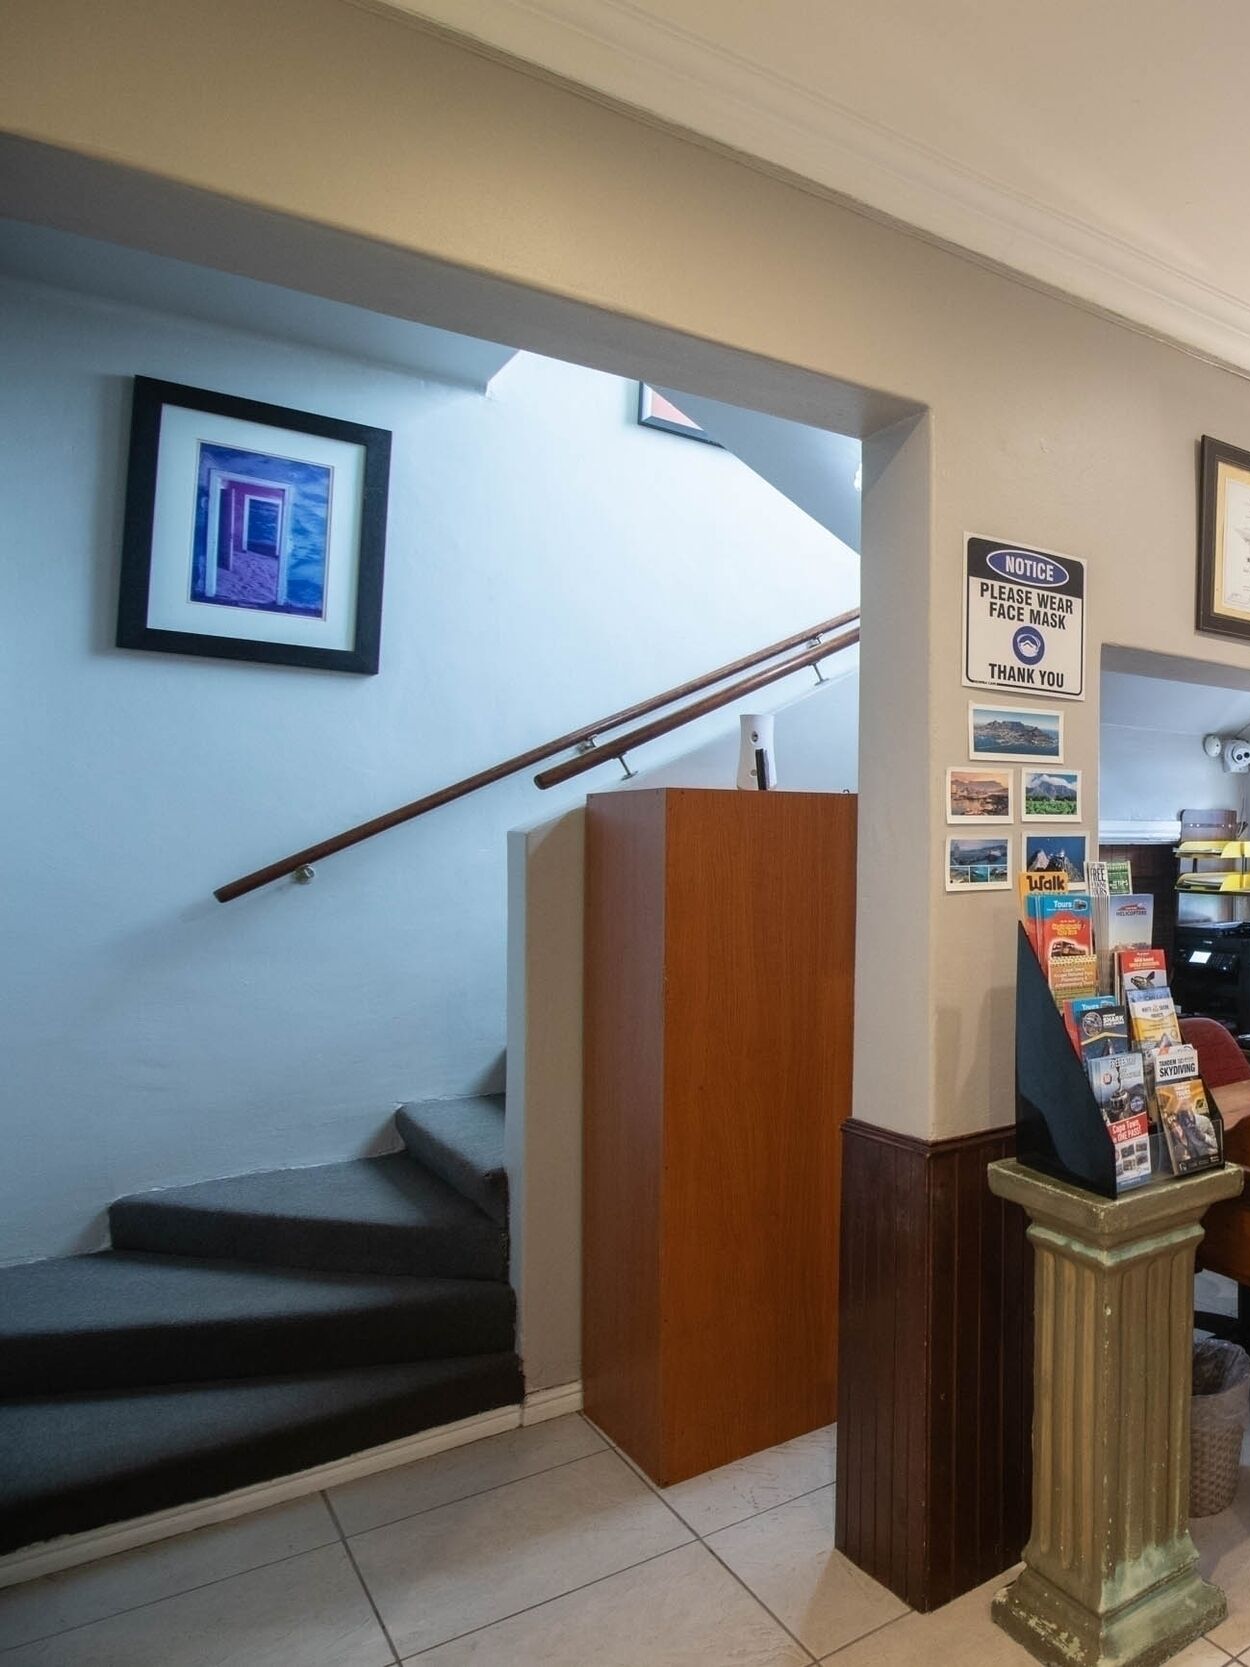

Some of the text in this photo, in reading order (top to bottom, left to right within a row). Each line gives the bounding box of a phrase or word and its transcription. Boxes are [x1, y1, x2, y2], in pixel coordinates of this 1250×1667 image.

[1005, 555, 1054, 582] NOTICE
[980, 582, 1073, 614] PLEASE WEAR
[989, 602, 1066, 630] FACE MASK
[988, 663, 1036, 684] THANK
[1038, 670, 1064, 688] YOU
[1026, 875, 1066, 892] Walk
[1053, 900, 1073, 908] Tours
[1158, 1058, 1177, 1067] TANDEM
[1159, 1063, 1196, 1078] SKYDIVING
